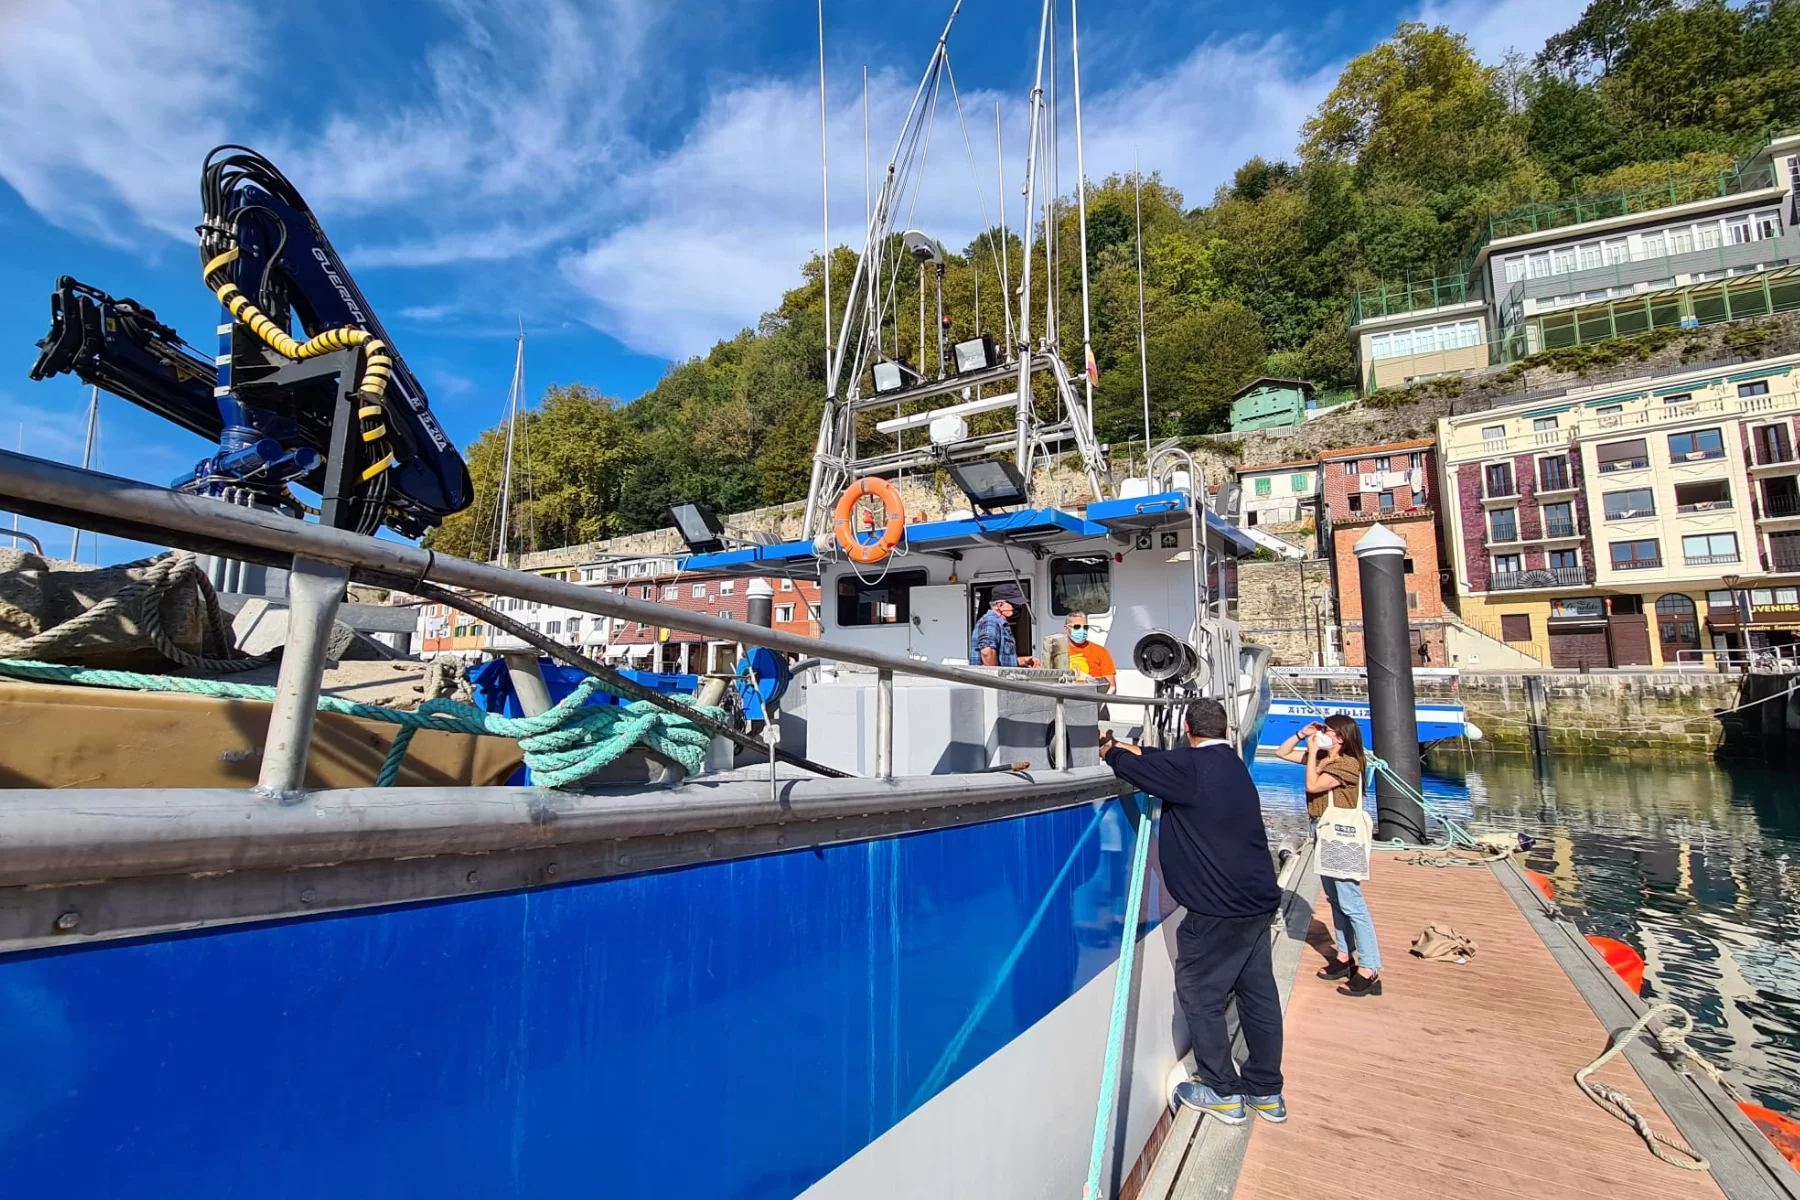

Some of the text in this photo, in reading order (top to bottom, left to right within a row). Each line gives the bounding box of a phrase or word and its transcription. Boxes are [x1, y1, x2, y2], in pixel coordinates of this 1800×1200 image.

[311, 247, 367, 323] GUERRA
[410, 397, 421, 407] M
[1736, 604, 1800, 612] UVENIRS
